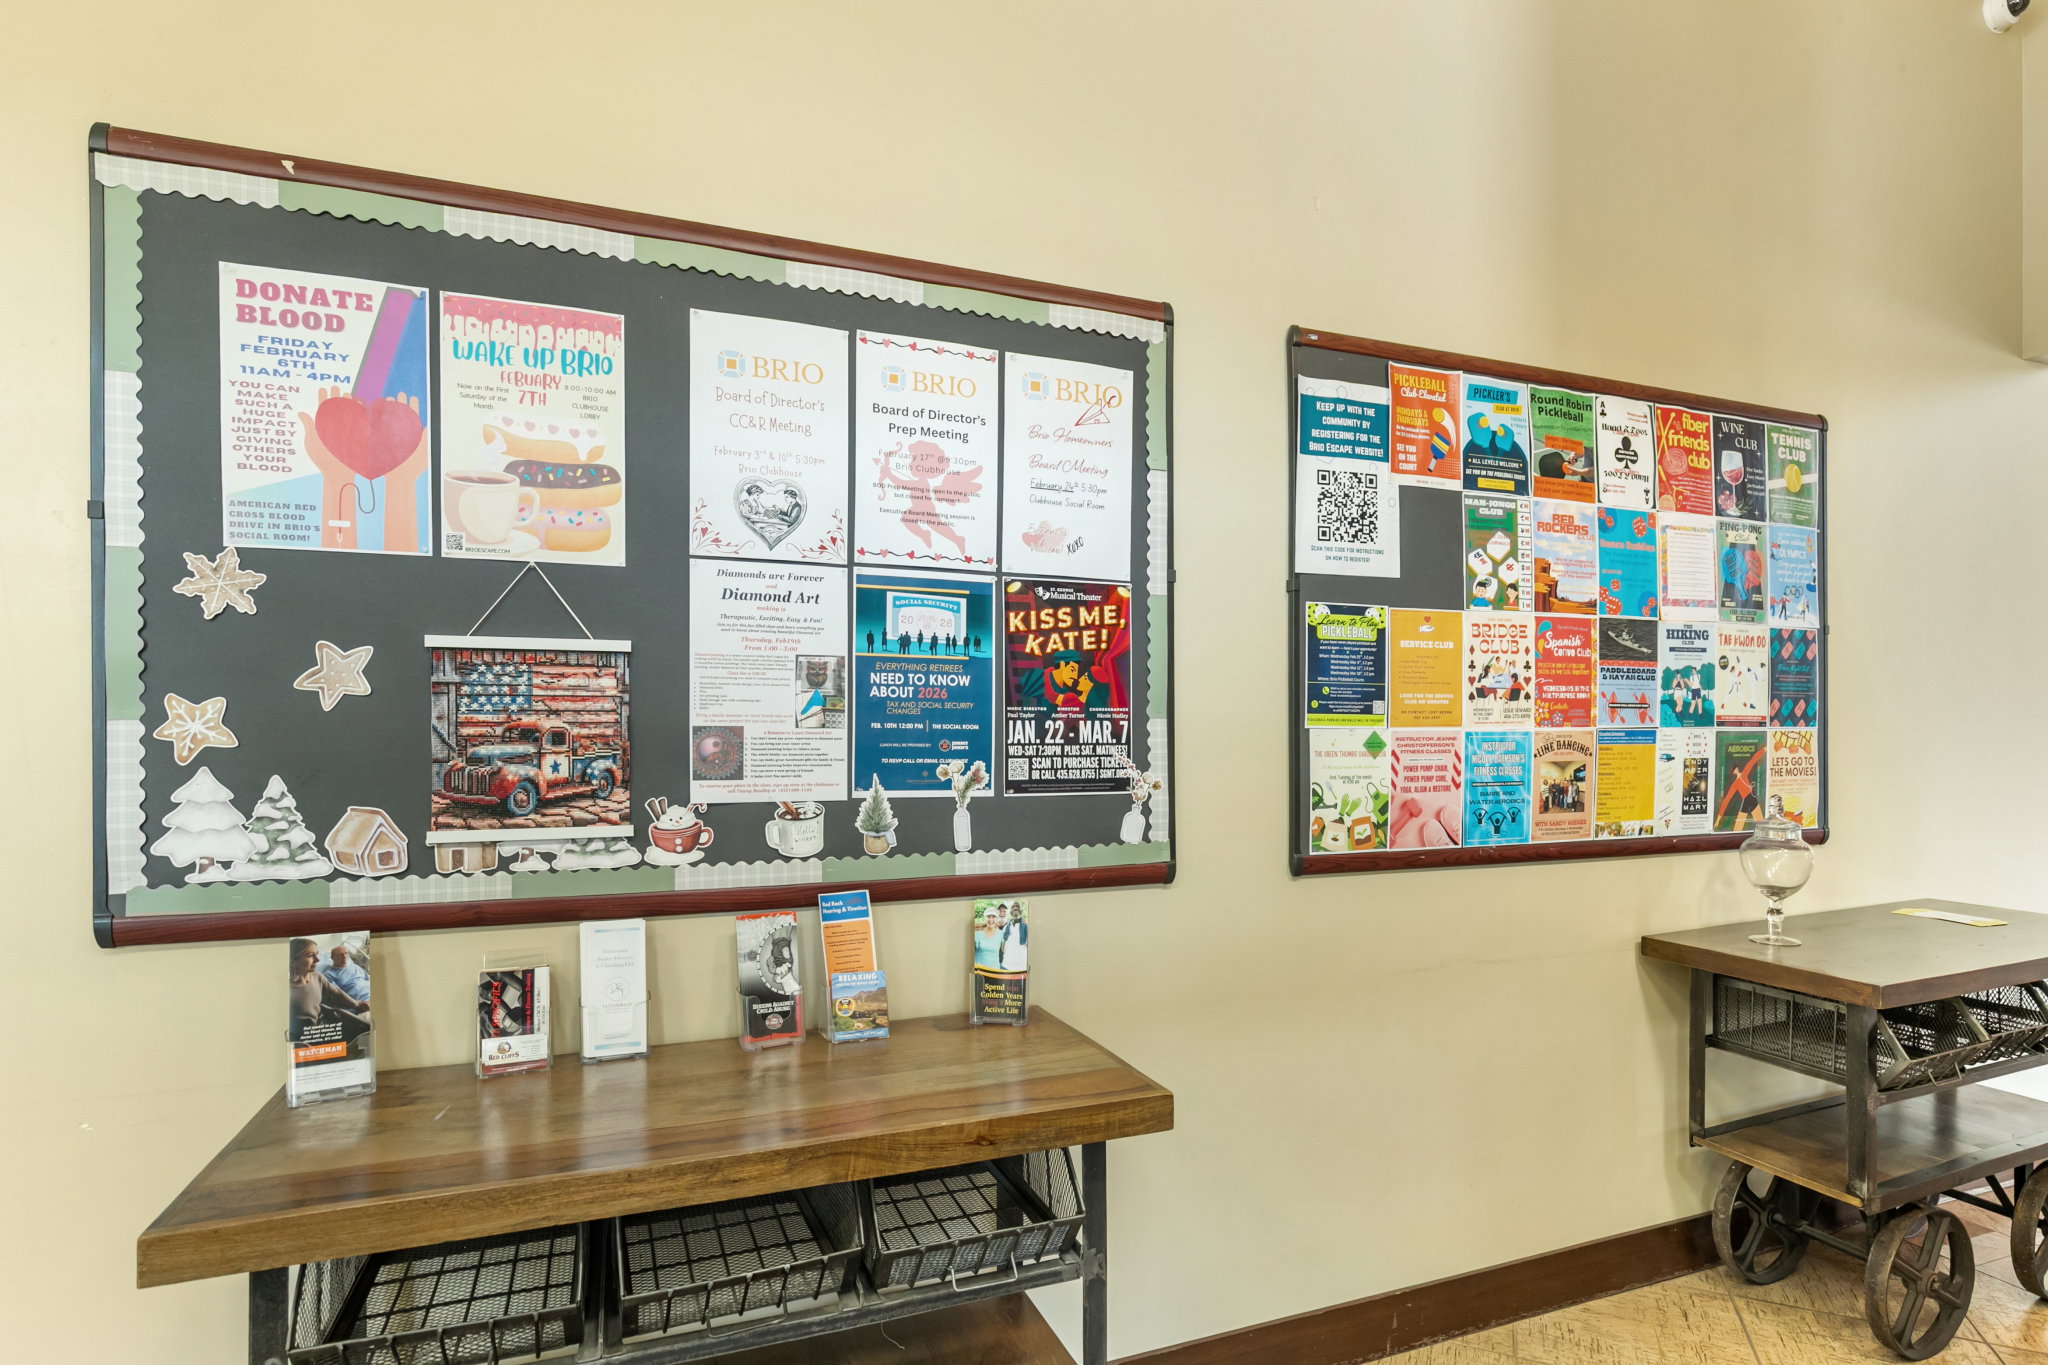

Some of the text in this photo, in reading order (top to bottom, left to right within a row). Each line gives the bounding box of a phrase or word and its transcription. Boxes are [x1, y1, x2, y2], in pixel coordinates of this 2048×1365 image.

[236, 279, 373, 312] DONATE
[236, 303, 345, 332] BLOOD
[258, 335, 333, 350] FRIDAY
[240, 344, 350, 362] FEBRUARY
[453, 339, 613, 377] WAKE UP BRIO
[278, 359, 315, 370] 6TH
[752, 356, 824, 385] BRIO
[229, 380, 300, 393] YOU CAN
[500, 371, 562, 390] FEBUARY
[912, 371, 977, 398] BRIO
[1394, 373, 1446, 393] PICKLEBALL
[237, 390, 288, 401] MAKE
[518, 389, 547, 406] 7TH
[716, 387, 825, 412] Board of Director's
[1055, 378, 1122, 408] BRIO
[1473, 387, 1511, 402] PICKLER'S
[235, 399, 293, 410] SUCH A
[572, 403, 609, 413] CLUBHOUSE
[1531, 393, 1592, 411] Round Robin
[243, 409, 286, 418] HUGE
[872, 403, 986, 426] Board of Director's
[1336, 403, 1346, 411] UP
[1347, 404, 1362, 414] WITH
[1363, 406, 1376, 416] THE
[1538, 406, 1584, 422] Pickleball
[232, 416, 297, 428] IMPACT
[729, 413, 812, 437] CC&R Meeting
[1396, 415, 1429, 427] THURSDAYS
[1682, 413, 1709, 433] fiber
[1721, 421, 1745, 435] WINE
[231, 426, 271, 435] JUST
[889, 422, 969, 444] Prep Meeting
[236, 435, 292, 446] GIVING
[1668, 429, 1710, 452] friends
[1735, 437, 1758, 451] CLUB
[1771, 432, 1812, 450] TENNIS
[232, 444, 296, 455] OTHERS
[1778, 447, 1806, 462] CLUB
[243, 454, 287, 463] YOUR
[1688, 451, 1710, 470] club
[237, 462, 293, 473] BLOOD
[229, 499, 317, 511] AMERICAN RED
[1465, 498, 1516, 508] MAH-JONGG
[229, 510, 306, 521] CROSS BLOOD
[1479, 507, 1503, 516] CLUB
[1552, 513, 1574, 524] RED
[229, 521, 264, 529] DRIVE
[284, 523, 321, 532] BRIO'S
[1537, 521, 1589, 536] ROCKERS
[1720, 522, 1762, 534] PING-PONG
[229, 531, 311, 542] SOCIAL ROOM!
[717, 568, 766, 580] Diamonds
[787, 573, 825, 583] Forever
[721, 588, 820, 605] Diamond Art
[1050, 592, 1102, 601] Musical Theater
[1008, 605, 1126, 633] KISS ME,
[1317, 615, 1379, 632] Learn to Play
[1322, 625, 1374, 639] PICKLEBALL
[1472, 623, 1528, 639] BRIDGE
[1666, 629, 1710, 640] HIKING
[1025, 628, 1109, 656] KATE!
[1400, 640, 1454, 649] SERVICE CLUB
[1479, 639, 1520, 654] CLUB
[1544, 631, 1582, 650] Spanish
[876, 662, 963, 673] EVERYTHING RETIREES
[1600, 667, 1656, 675] PADDLEBOARD
[870, 672, 970, 686] NEED TO KNOW
[870, 686, 948, 699] ABOUT 2026
[886, 700, 899, 708] TAX
[918, 701, 943, 709] SOCIAL
[1007, 720, 1040, 744] JAN.
[1045, 720, 1064, 743] 22
[1079, 720, 1116, 743] MAR.
[1120, 720, 1128, 743] 7
[1008, 744, 1128, 756] WED-SAT 7:30PM PLUS SAT. MATINEES!
[1537, 740, 1590, 757] LINE DANCING
[1772, 756, 1814, 767] LETS GO TO
[1032, 769, 1040, 779] OR
[1041, 769, 1056, 779] CALL
[1770, 766, 1816, 777] THE MOVIES!
[838, 972, 878, 982] RELAXING
[984, 983, 1005, 991] Spend
[298, 1045, 342, 1057] WATCHMAN
